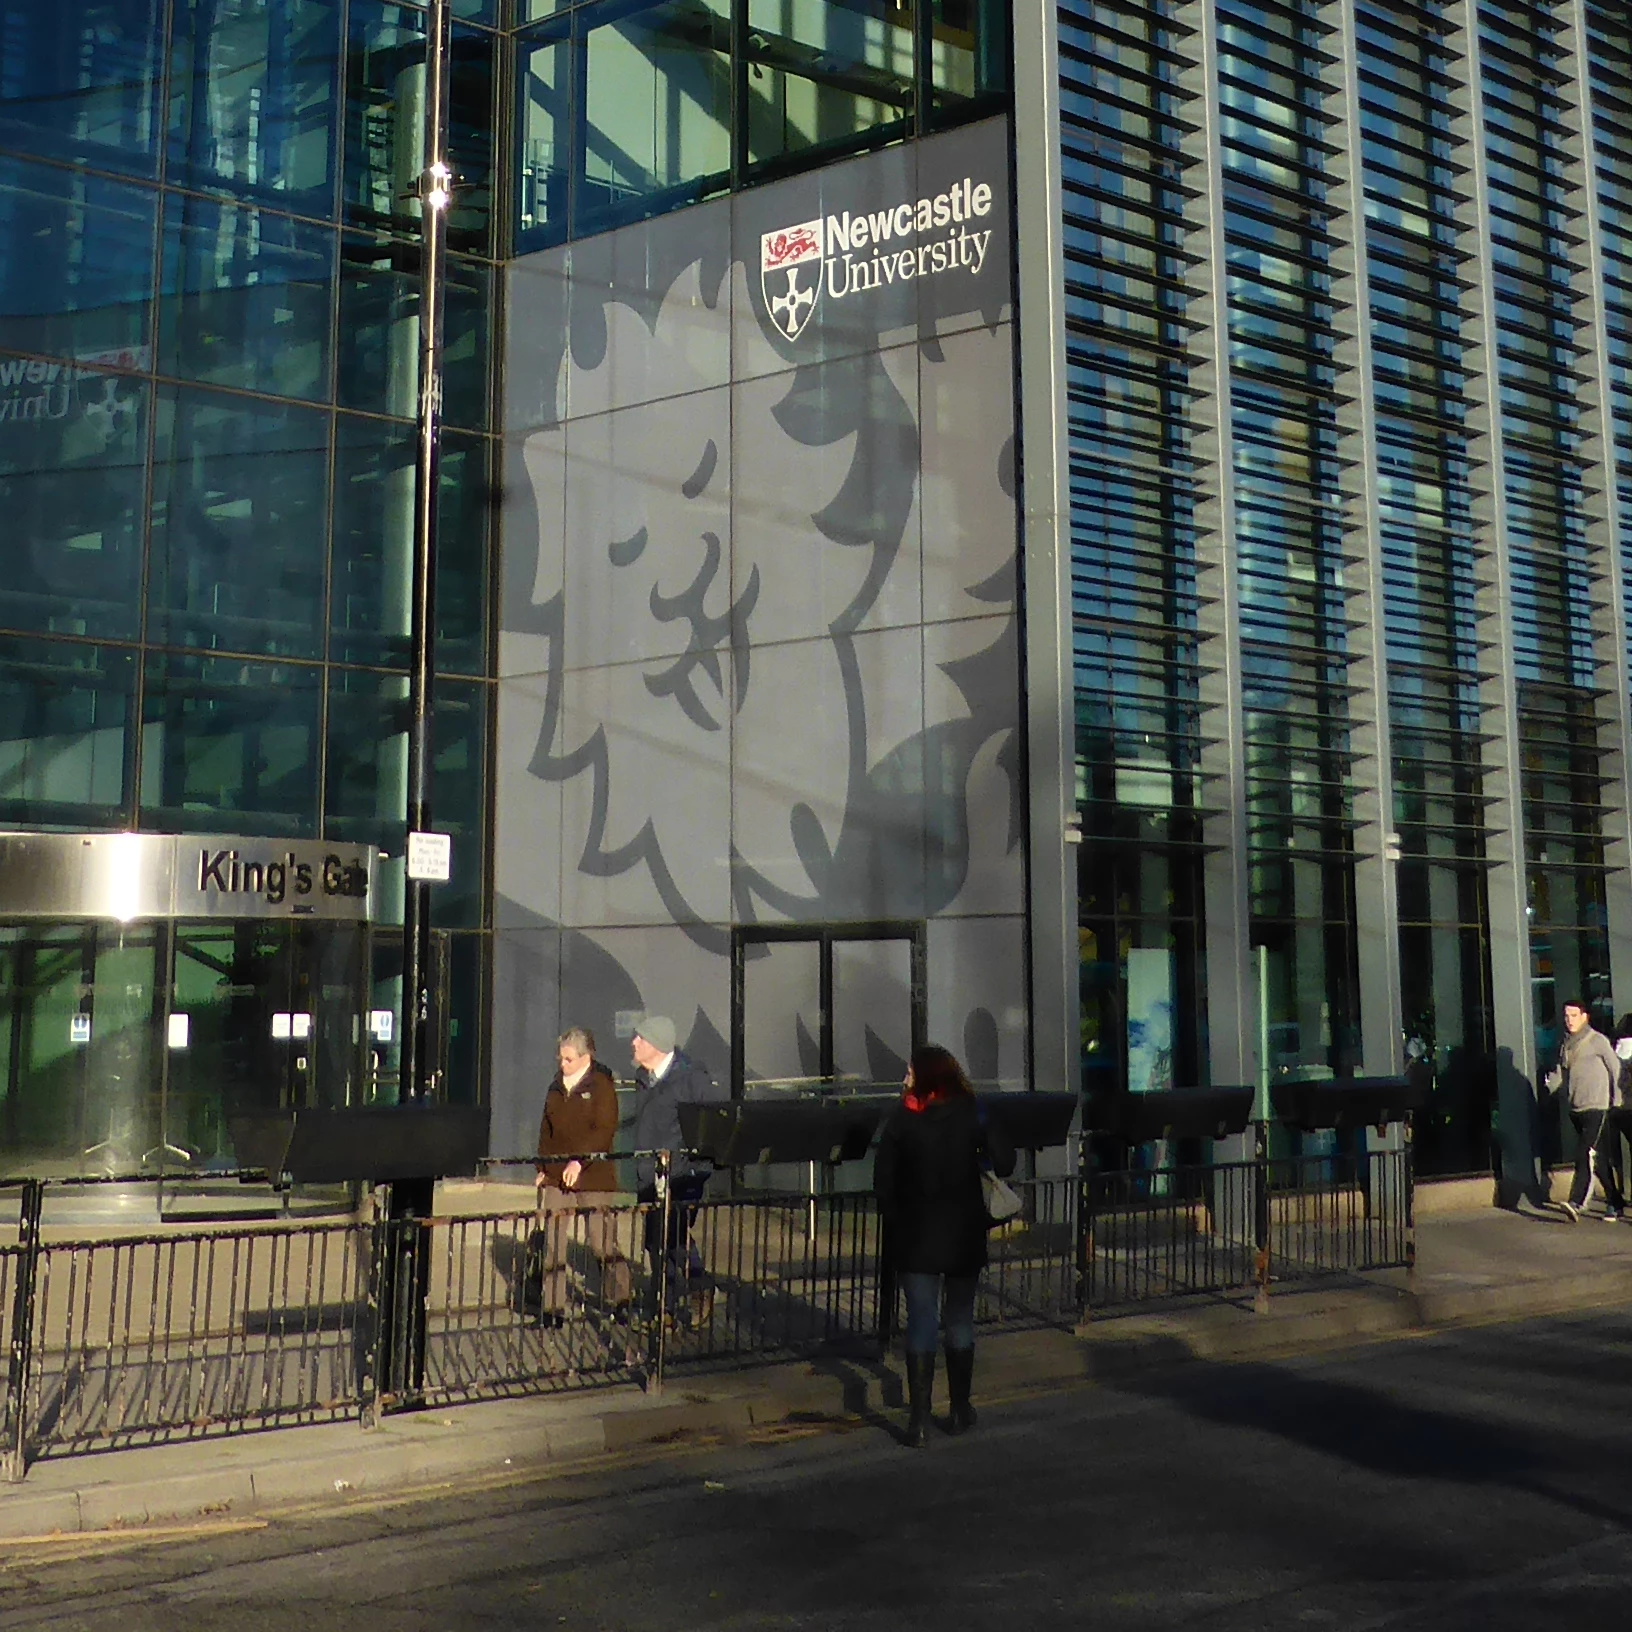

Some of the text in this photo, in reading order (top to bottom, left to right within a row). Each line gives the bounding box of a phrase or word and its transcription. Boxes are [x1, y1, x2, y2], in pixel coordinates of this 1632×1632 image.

[826, 176, 993, 256] Newcastle
[824, 225, 992, 300] University
[197, 849, 313, 904] King's
